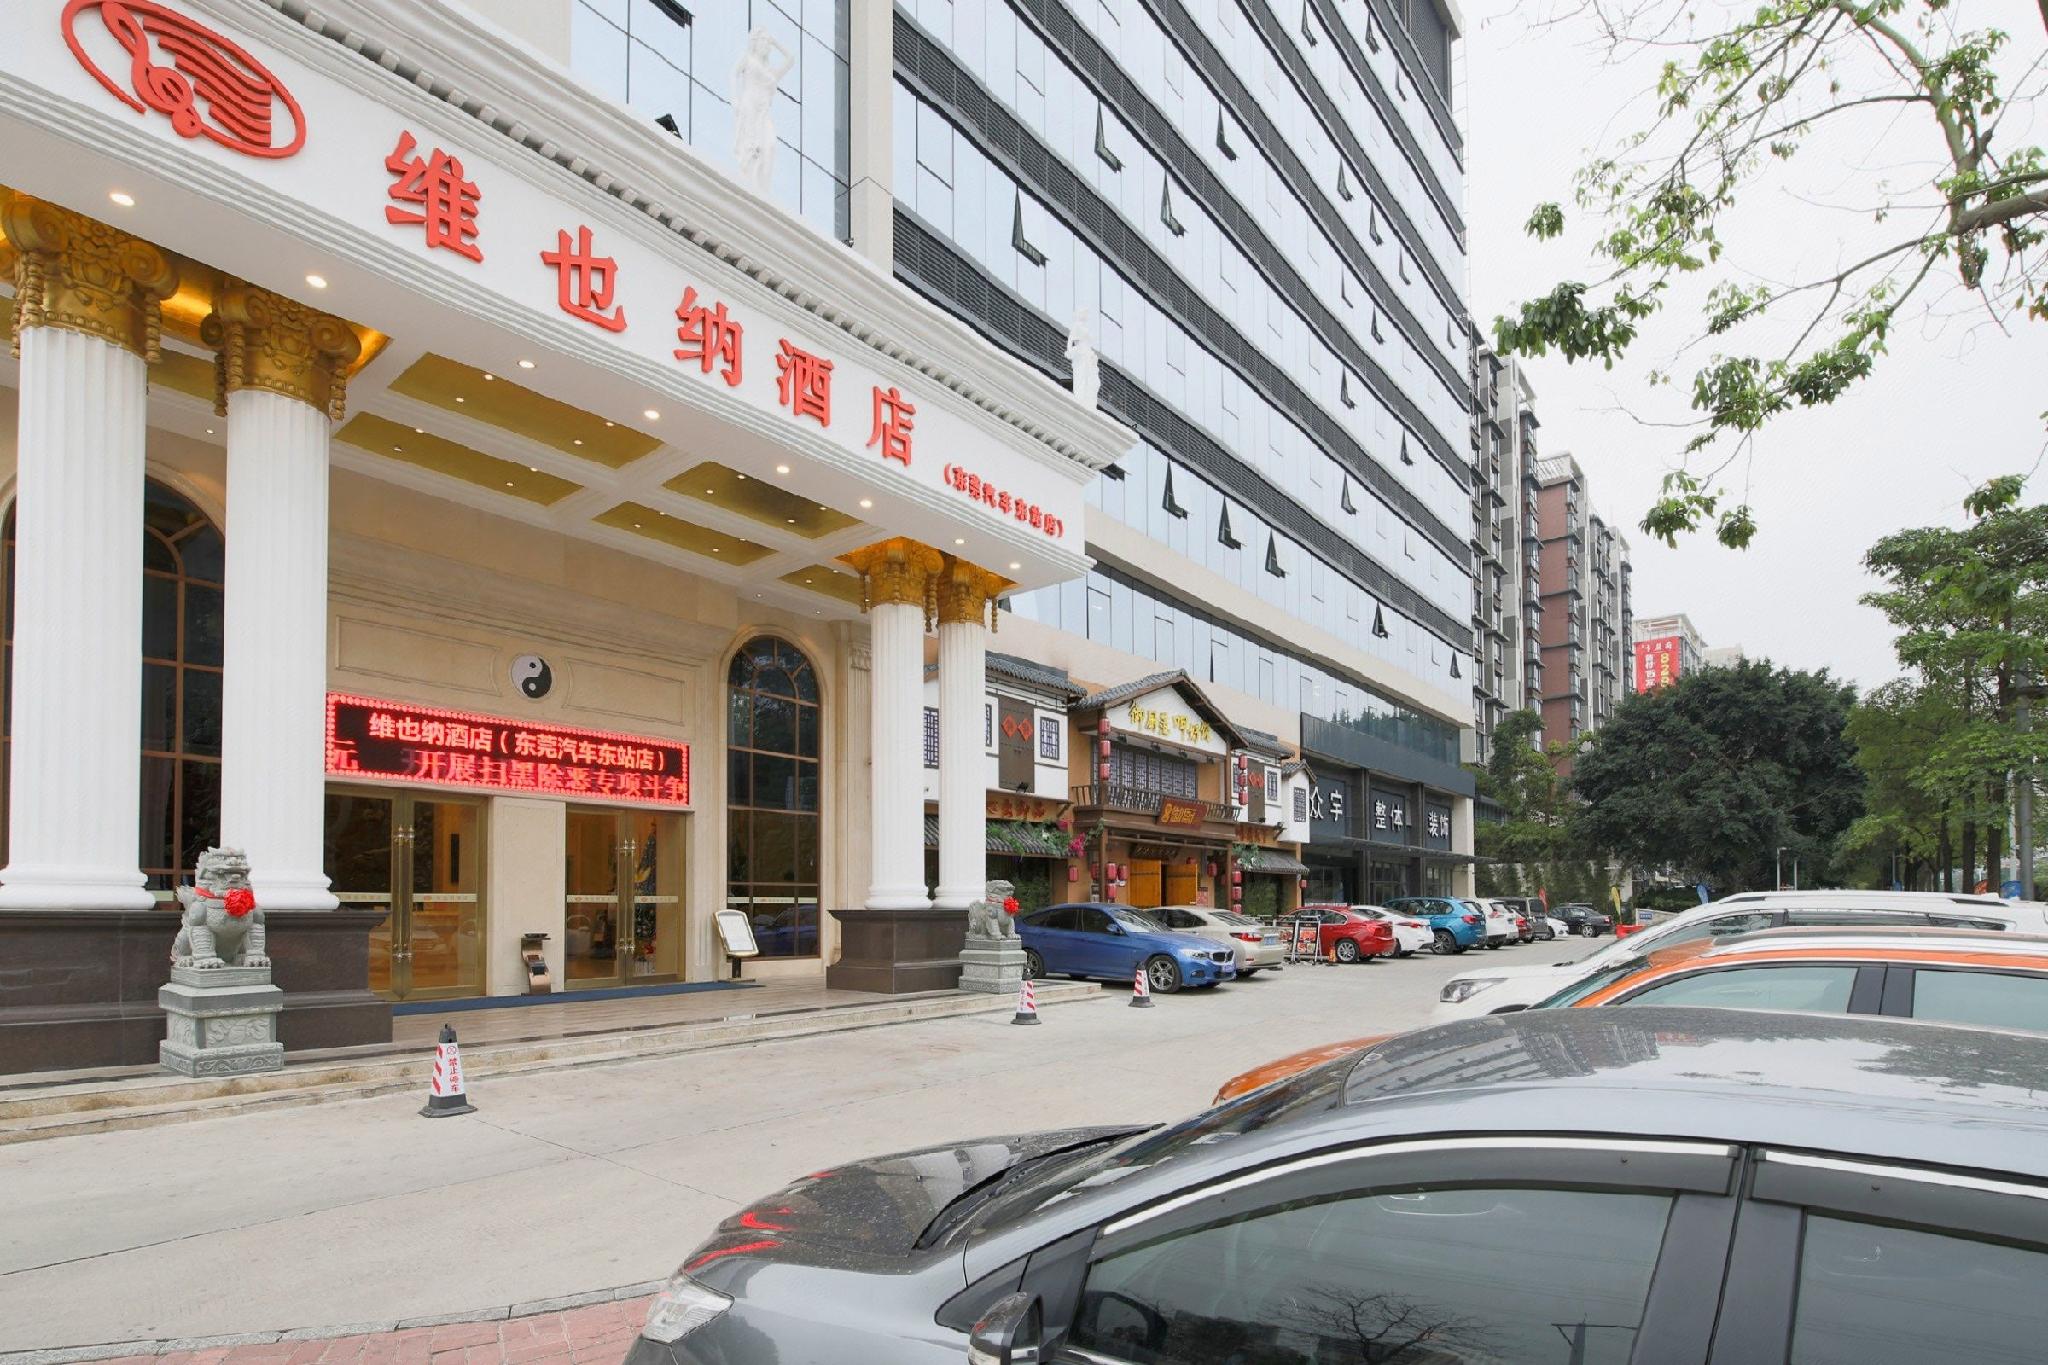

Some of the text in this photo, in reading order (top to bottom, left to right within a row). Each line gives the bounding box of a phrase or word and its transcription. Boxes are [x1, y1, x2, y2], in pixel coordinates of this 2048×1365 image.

[384, 130, 918, 467] 维也纳酒店
[1375, 799, 1403, 831] 整体
